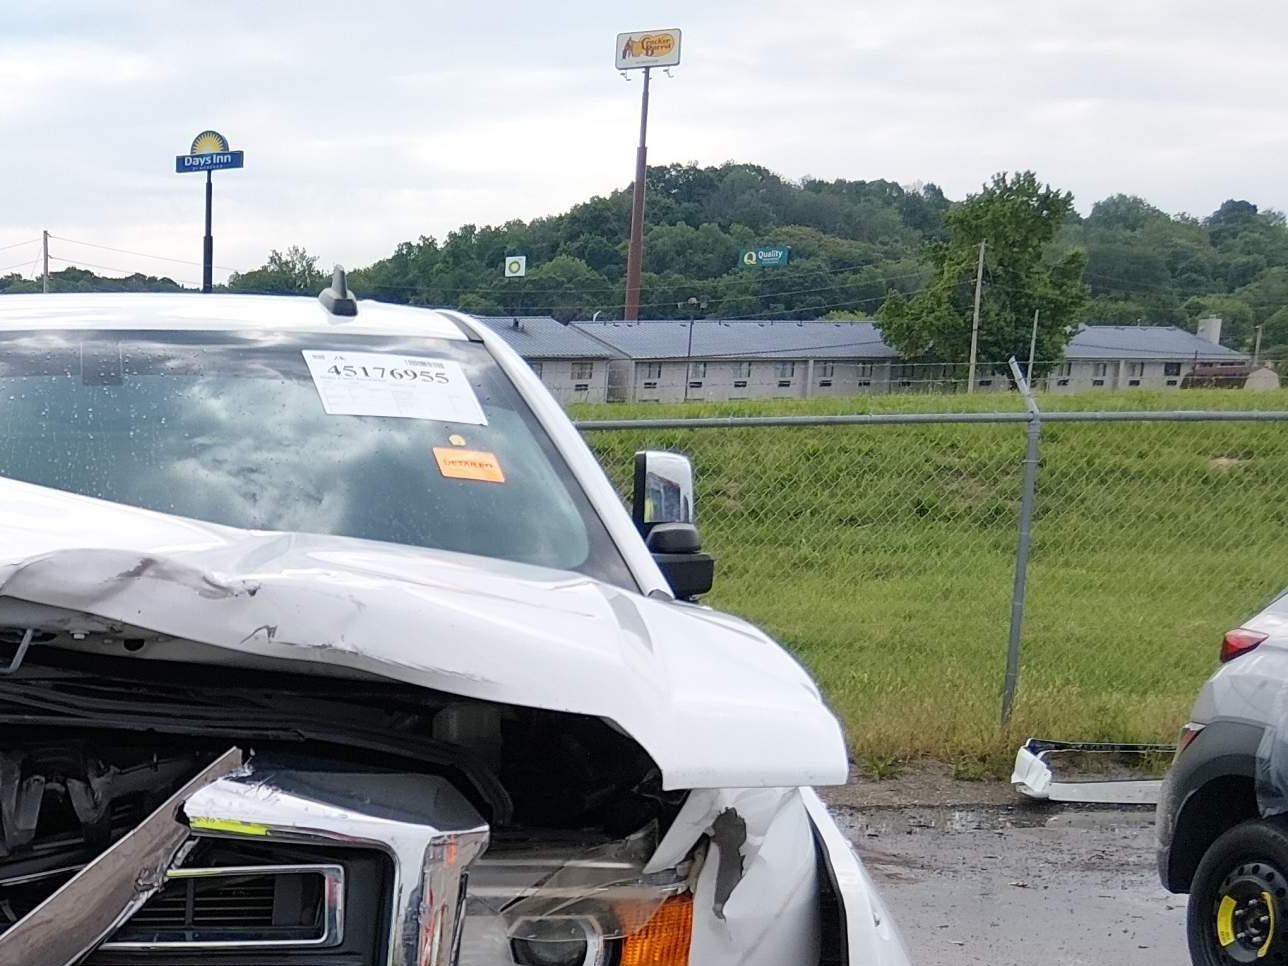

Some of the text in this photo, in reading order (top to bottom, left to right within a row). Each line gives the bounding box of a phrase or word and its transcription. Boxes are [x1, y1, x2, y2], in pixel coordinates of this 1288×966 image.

[184, 154, 231, 167] Days Inn
[758, 249, 783, 260] Quality
[327, 364, 450, 384] 45176955
